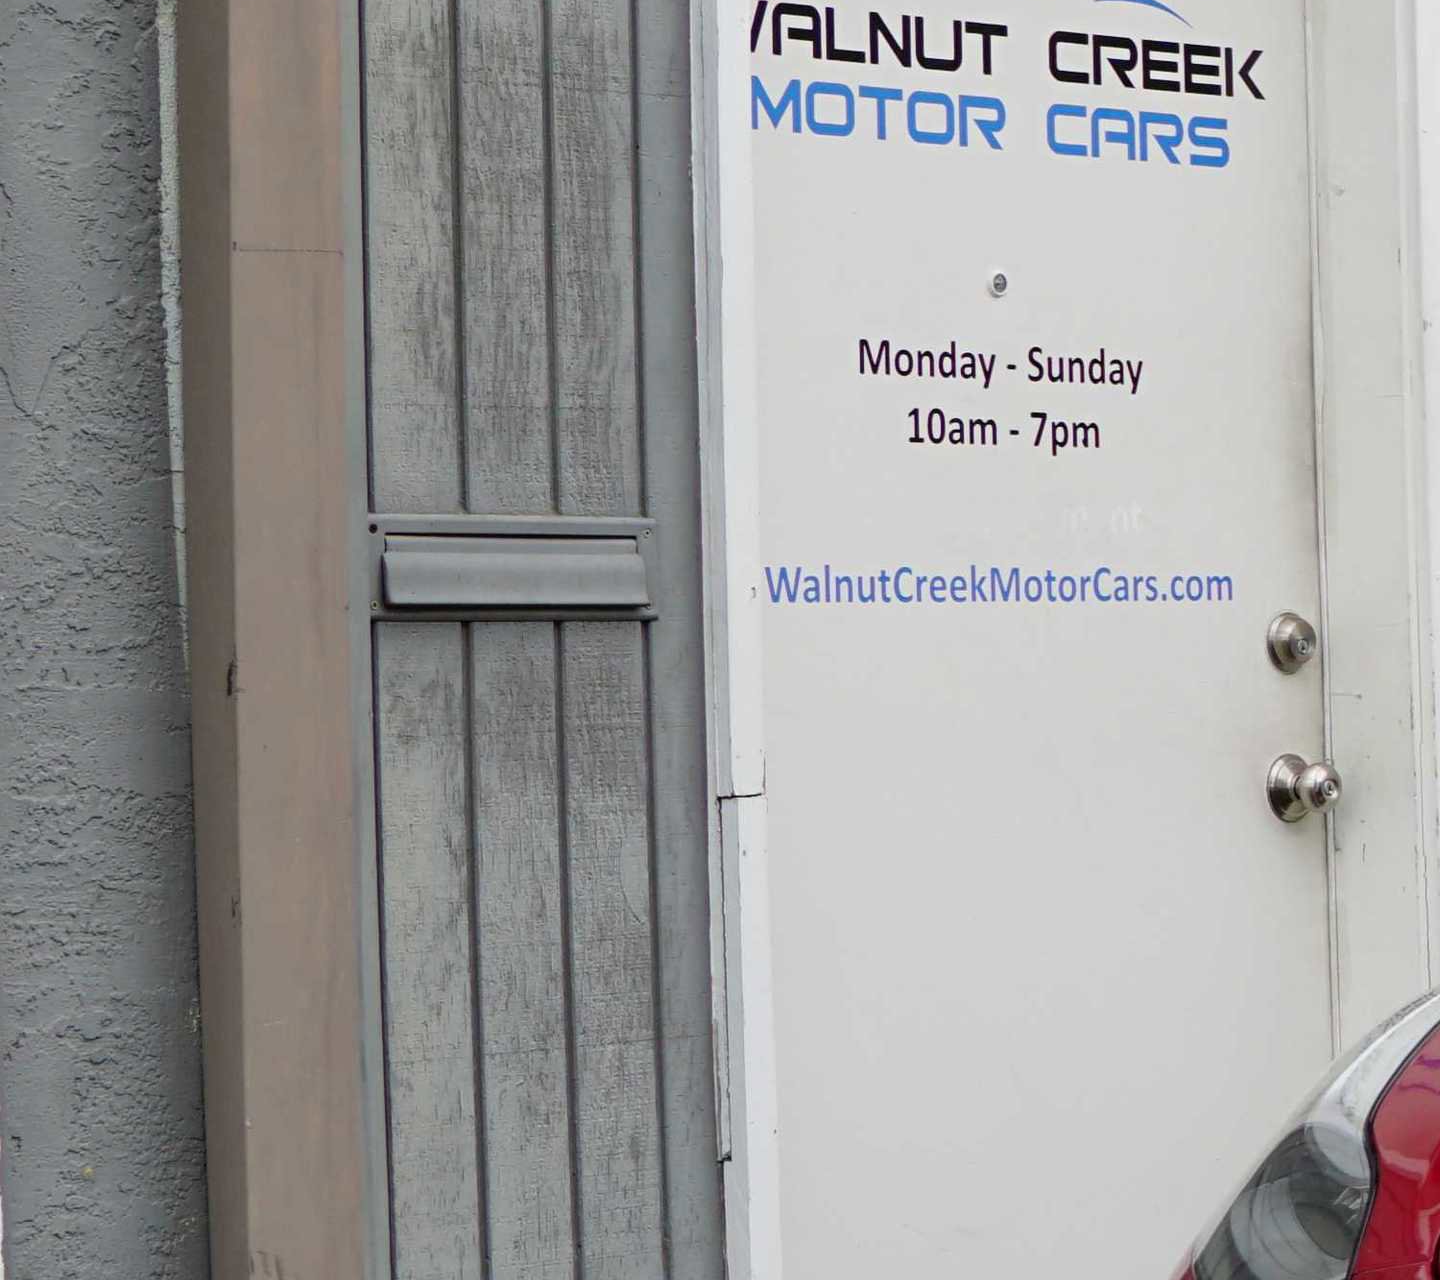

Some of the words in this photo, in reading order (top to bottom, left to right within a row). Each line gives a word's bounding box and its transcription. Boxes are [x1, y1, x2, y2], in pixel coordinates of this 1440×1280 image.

[1048, 30, 1266, 101] CREEK
[751, 75, 1007, 150] MOTOR
[1046, 103, 1231, 169] CARS
[858, 337, 997, 390] Monday
[1027, 347, 1144, 394] Sunday
[906, 408, 999, 447] 10am
[1030, 412, 1101, 456] 7pm
[765, 563, 1234, 605] WalnutCreekMotorCars.com
